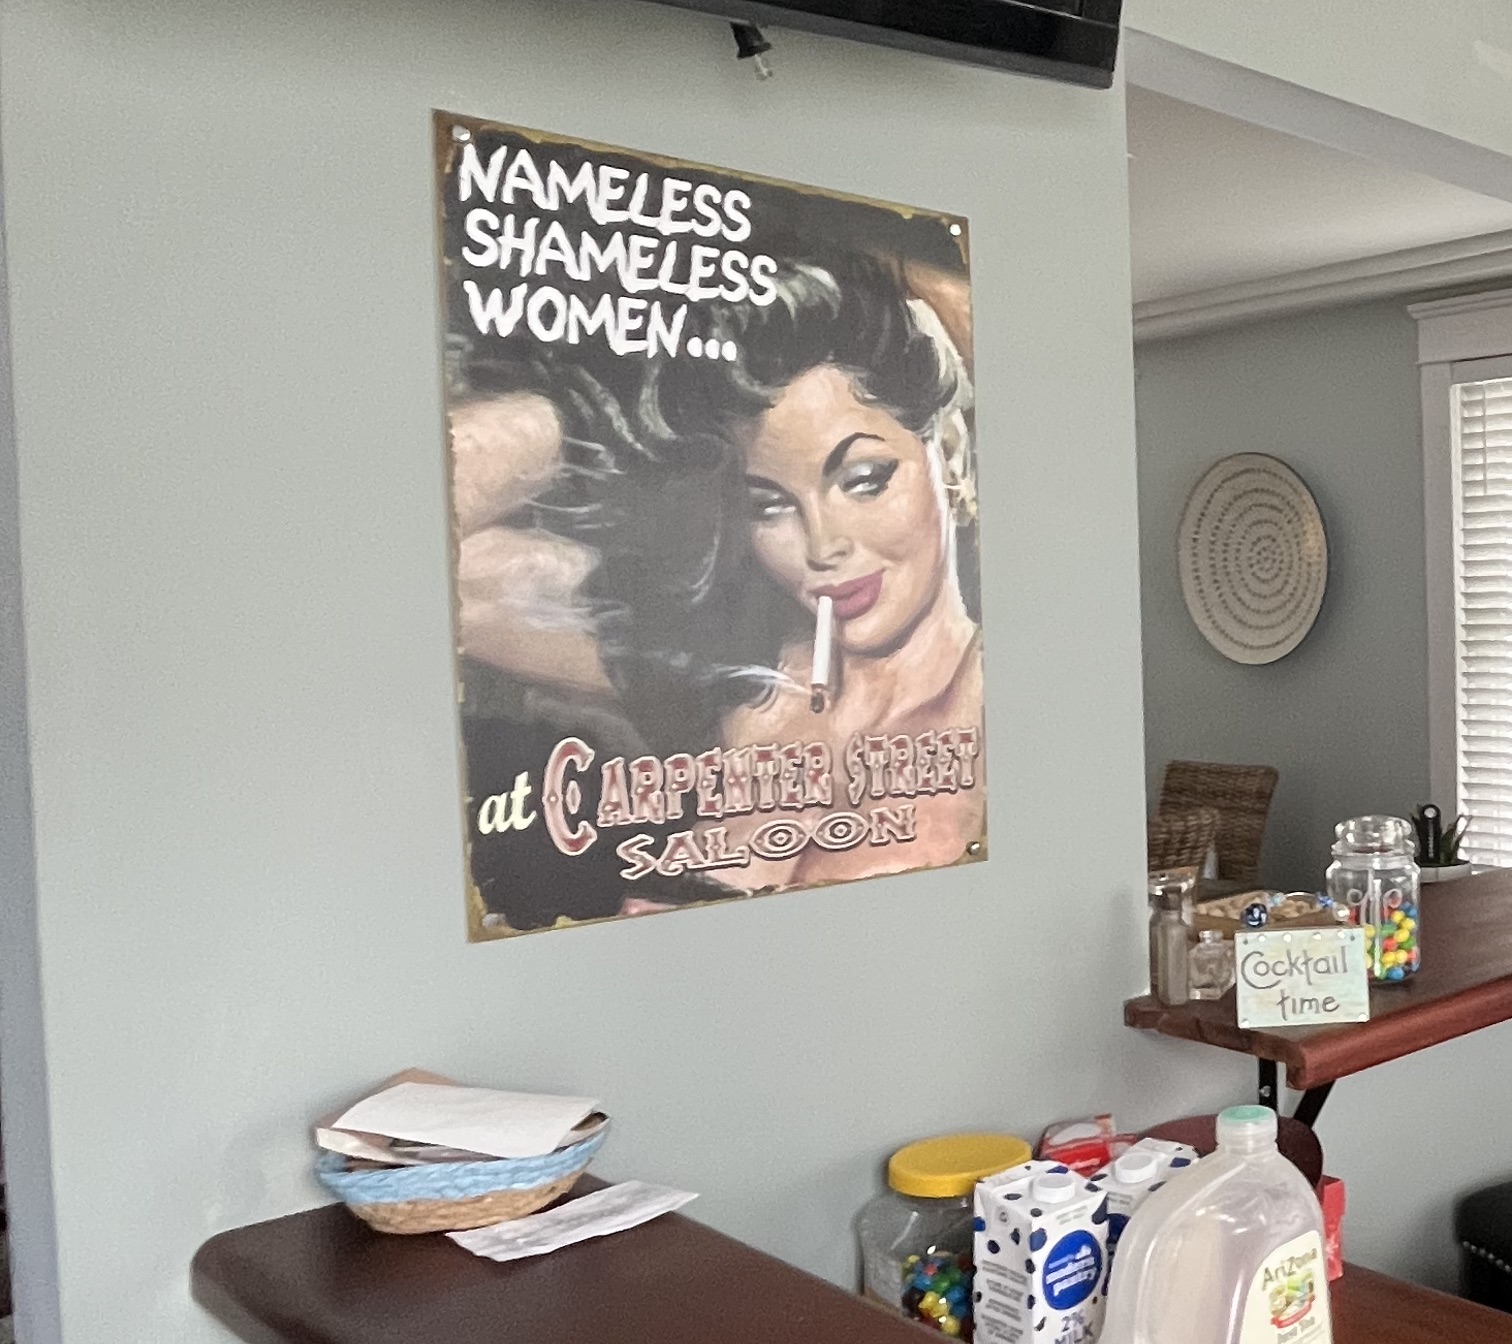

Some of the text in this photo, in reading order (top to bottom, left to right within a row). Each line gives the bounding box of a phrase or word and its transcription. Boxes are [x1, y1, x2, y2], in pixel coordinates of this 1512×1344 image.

[459, 143, 752, 243] NAMELESS
[462, 208, 778, 306] SHAMELESS
[462, 280, 738, 361] WOMEN...
[477, 726, 979, 856] at CARPENTER STREET
[615, 802, 918, 881] SALOON
[1240, 945, 1349, 990] Cocktail
[1276, 988, 1341, 1022] time
